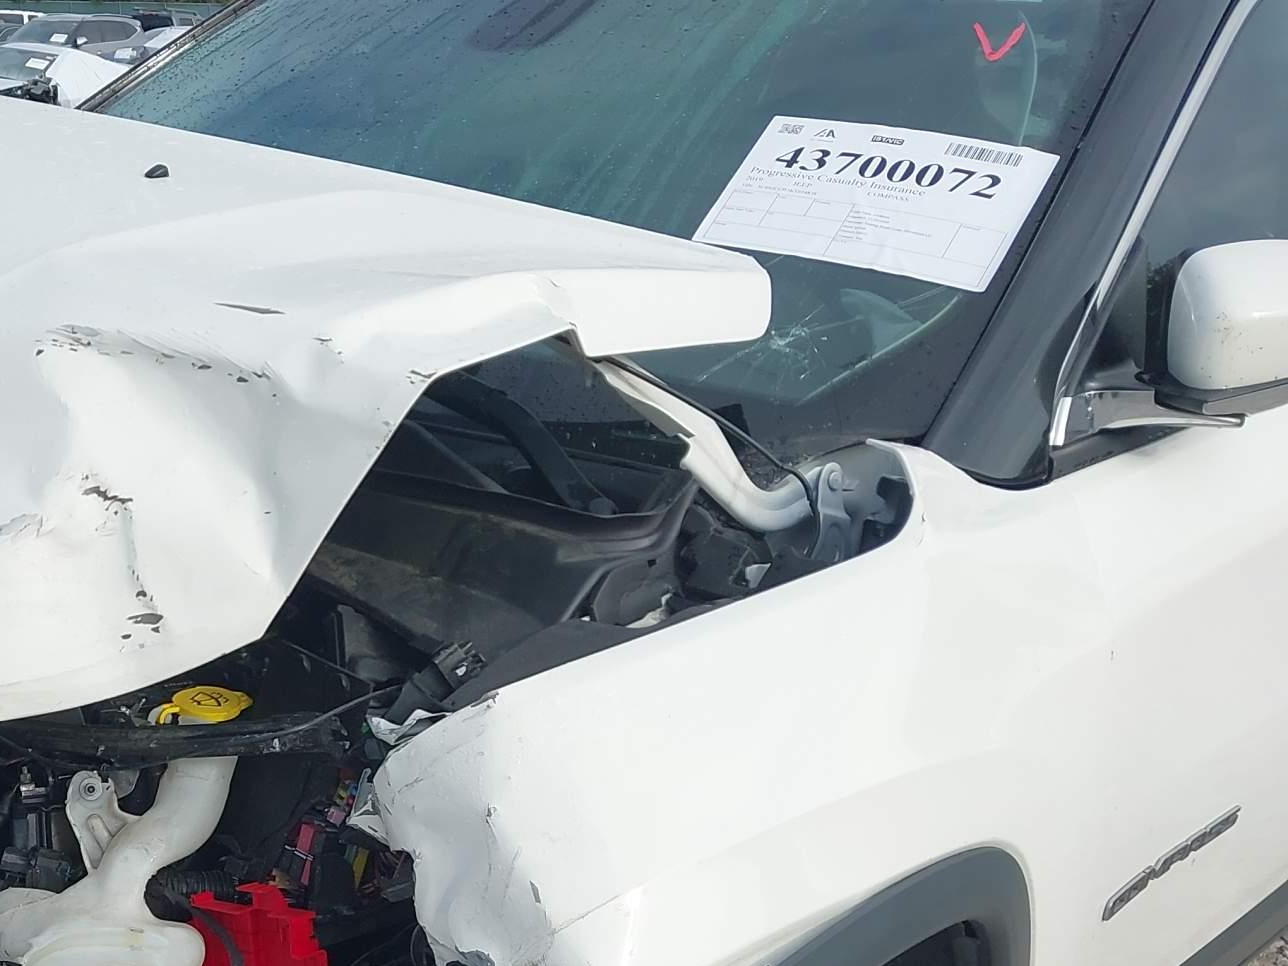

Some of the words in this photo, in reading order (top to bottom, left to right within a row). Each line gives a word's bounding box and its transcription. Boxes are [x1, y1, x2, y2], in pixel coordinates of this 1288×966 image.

[750, 166, 815, 181] Progressive
[816, 174, 867, 189] Casualty
[870, 181, 926, 197] Insurance
[775, 145, 1002, 200] 43700072
